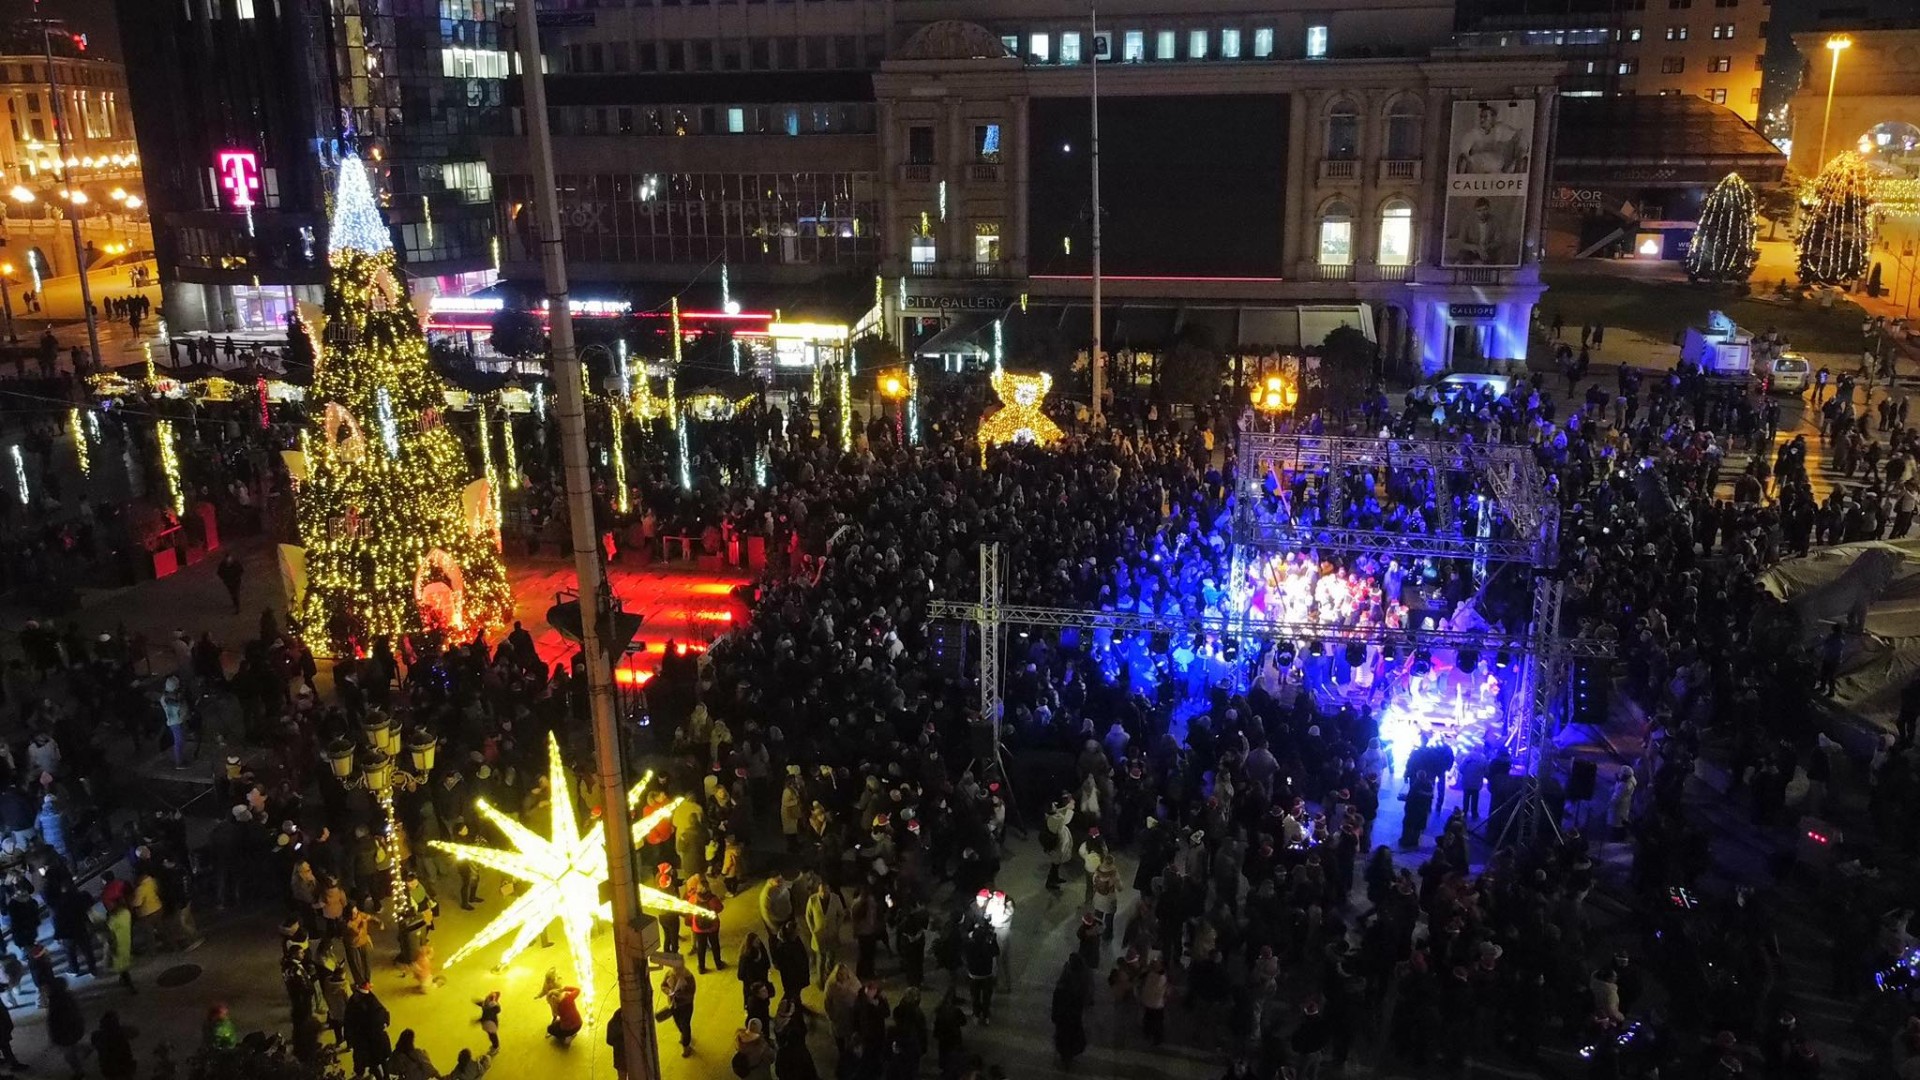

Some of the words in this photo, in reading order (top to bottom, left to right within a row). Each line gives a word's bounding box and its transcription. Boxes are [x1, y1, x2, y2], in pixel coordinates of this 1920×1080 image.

[1452, 179, 1523, 190] CALLIOPE
[1551, 187, 1602, 202] LUXOR
[639, 203, 710, 216] OFFICE
[905, 297, 938, 308] CITY
[940, 297, 1005, 308] GALLERY
[1451, 307, 1495, 315] CALLIOPE
